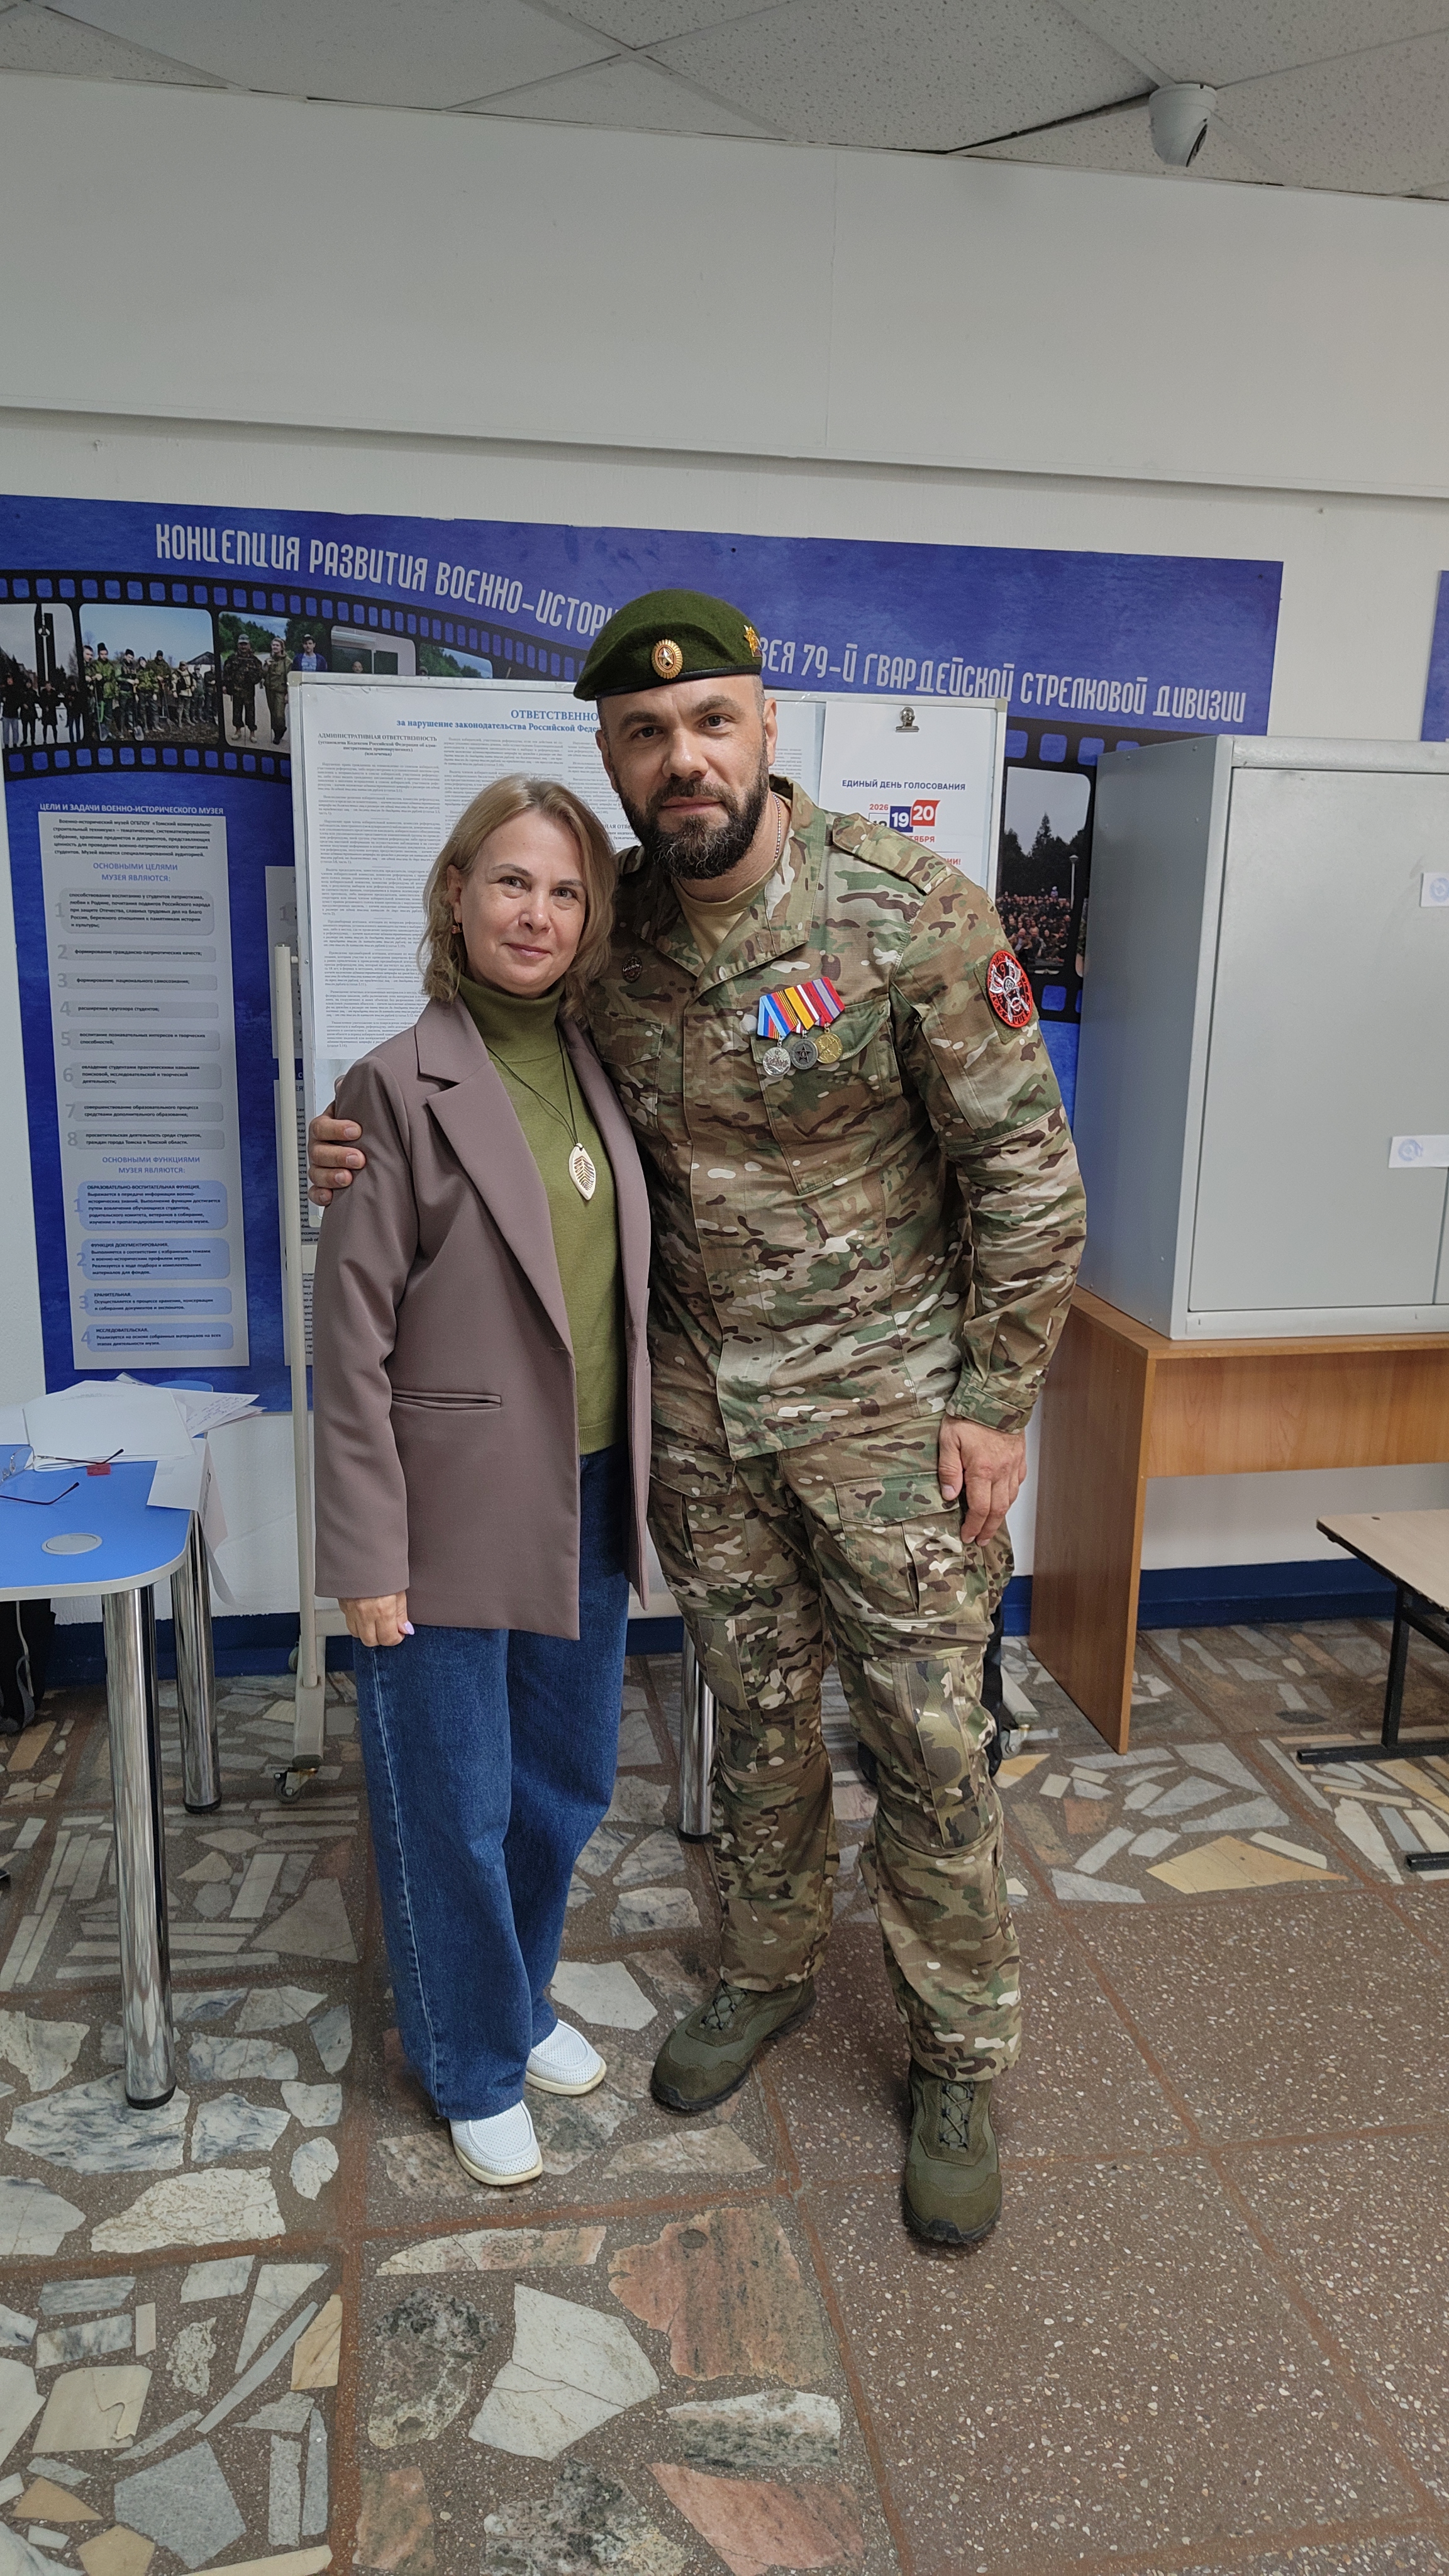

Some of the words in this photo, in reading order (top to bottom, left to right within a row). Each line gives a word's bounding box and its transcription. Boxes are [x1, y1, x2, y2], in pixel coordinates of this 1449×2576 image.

[156, 523, 300, 572] КОНЦЕПЦИЯ
[309, 539, 428, 592] РАЗВИТИЯ
[760, 636, 796, 674] ЗЕЯ
[801, 643, 858, 683] 79-Й
[863, 653, 1014, 702] ГВАРДЕЙСКОЙ
[1020, 672, 1148, 715] СТРЕЛКОВОЙ
[1152, 686, 1246, 723] ДИВИЗИИ
[511, 709, 598, 721] ОТВЕТСТВЕННО
[407, 720, 453, 730] нарушение
[455, 722, 526, 731] законодательства
[528, 723, 575, 731] Российской
[577, 724, 600, 733] Феде
[842, 778, 877, 788] ЕДИНЫЙ
[879, 780, 902, 789] ДЕНЬ
[904, 781, 966, 790] ГОЛОСОВАНИЯ
[40, 802, 60, 813] ЦЕЛИ
[62, 803, 68, 813] И
[69, 803, 100, 814] ЗАДАЧИ
[101, 804, 197, 816] ВОЕННО-ИСТОРИЧЕСКОГО
[198, 807, 224, 816] МУЗЕЯ
[891, 812, 909, 828] 19
[913, 806, 934, 821] 20
[145, 863, 178, 872] ЦЕЛЯМИ
[55, 902, 65, 918] 1
[57, 944, 69, 960] 2
[57, 973, 68, 988] 3
[60, 1001, 70, 1016] 4
[61, 1031, 71, 1046] 5
[63, 1068, 74, 1082] 6
[65, 1104, 75, 1118] 7
[67, 1132, 78, 1146] 8
